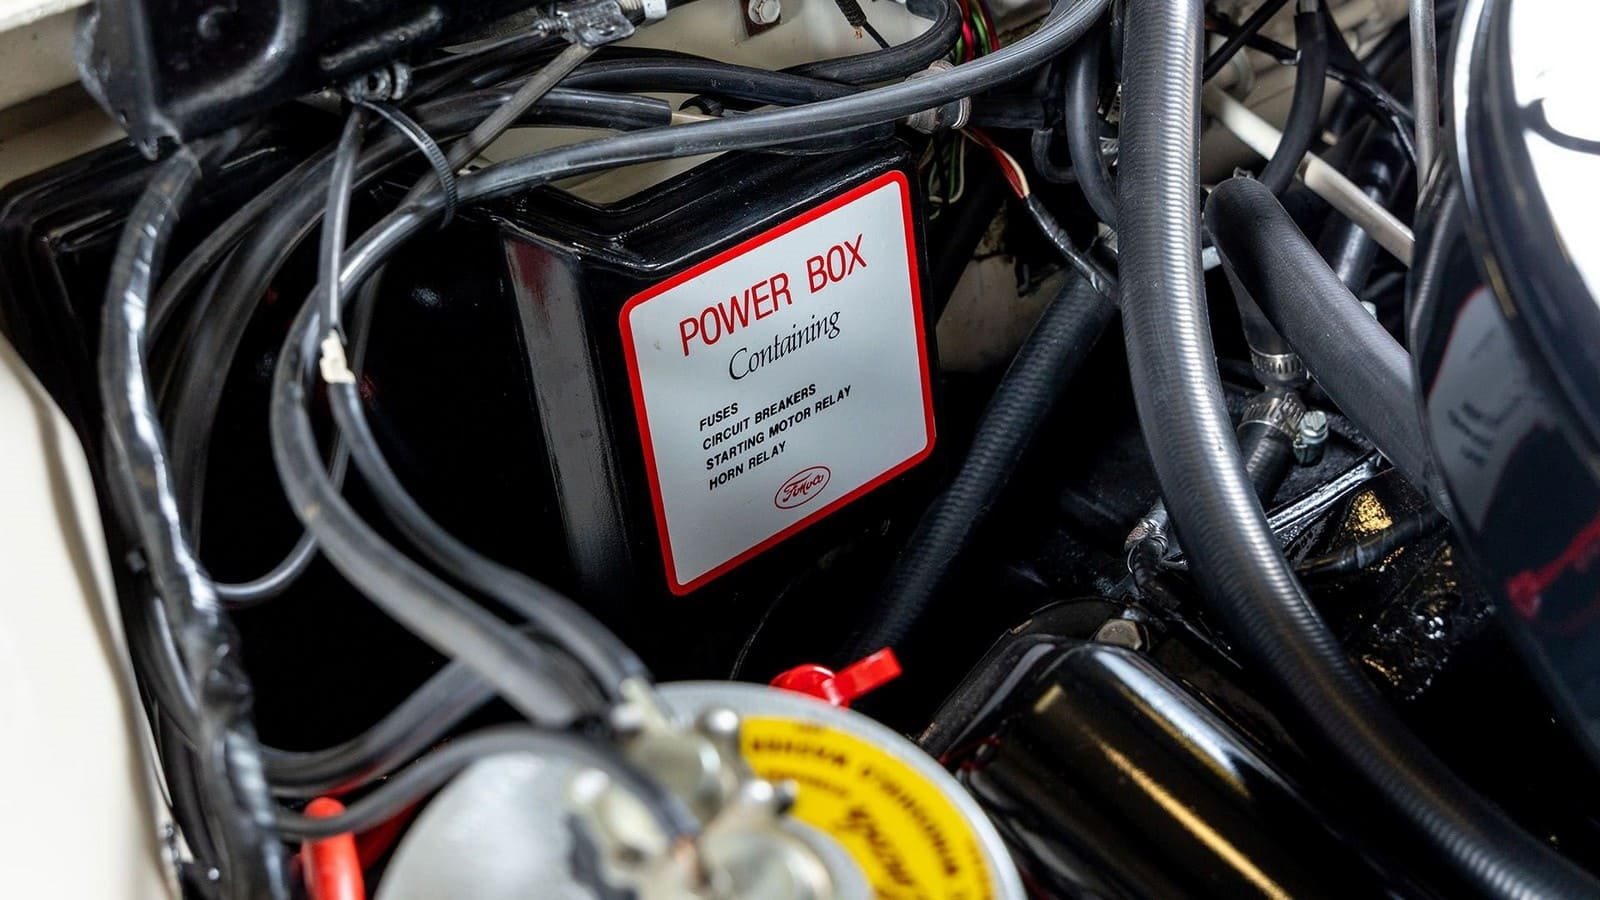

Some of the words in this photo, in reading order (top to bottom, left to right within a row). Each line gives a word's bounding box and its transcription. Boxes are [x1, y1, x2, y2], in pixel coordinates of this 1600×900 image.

[679, 272, 792, 357] POWER
[806, 233, 868, 294] BOX
[728, 311, 841, 380] Containing
[699, 402, 738, 431] FUSES
[702, 417, 750, 450] CIRCUIT
[754, 383, 816, 424] BREAKERS
[706, 432, 765, 470] STARTING
[768, 407, 811, 438] MOTOR
[814, 385, 851, 413] RELAY
[709, 463, 744, 490] HORN
[748, 441, 786, 469] RELAY
